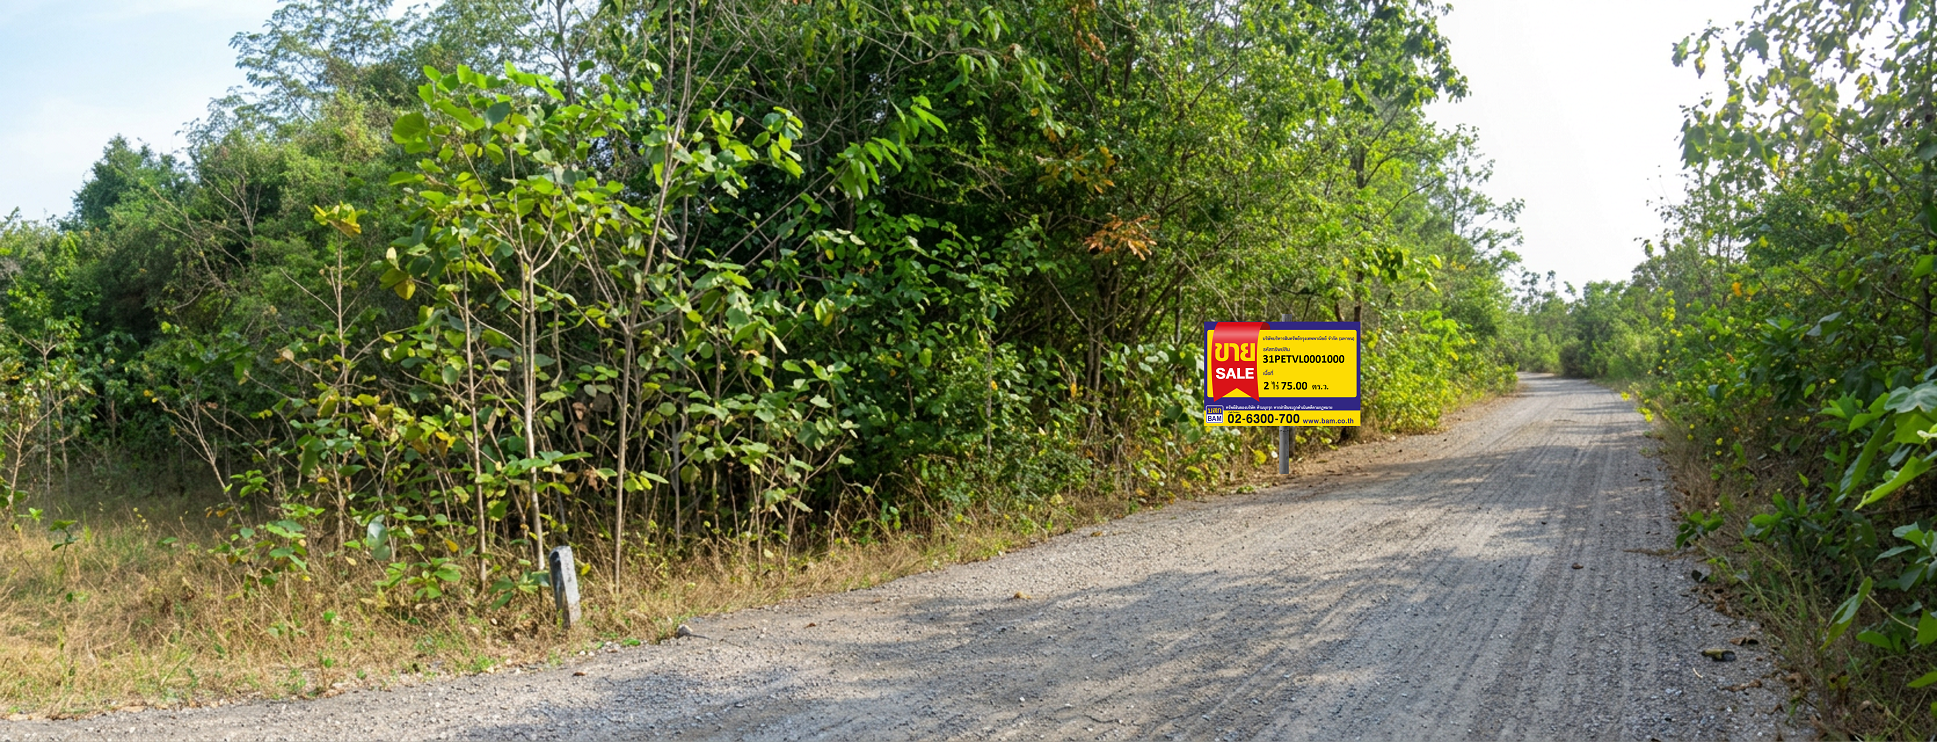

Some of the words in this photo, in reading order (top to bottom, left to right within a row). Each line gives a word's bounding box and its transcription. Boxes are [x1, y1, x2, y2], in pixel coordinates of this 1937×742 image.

[1215, 343, 1255, 361] ขาย
[1263, 355, 1345, 363] 31PETVL0001000
[1216, 368, 1254, 379] SALE
[1263, 382, 1269, 390] 2
[1281, 382, 1308, 390] 75.00
[1228, 414, 1300, 424] 02-6300-700
